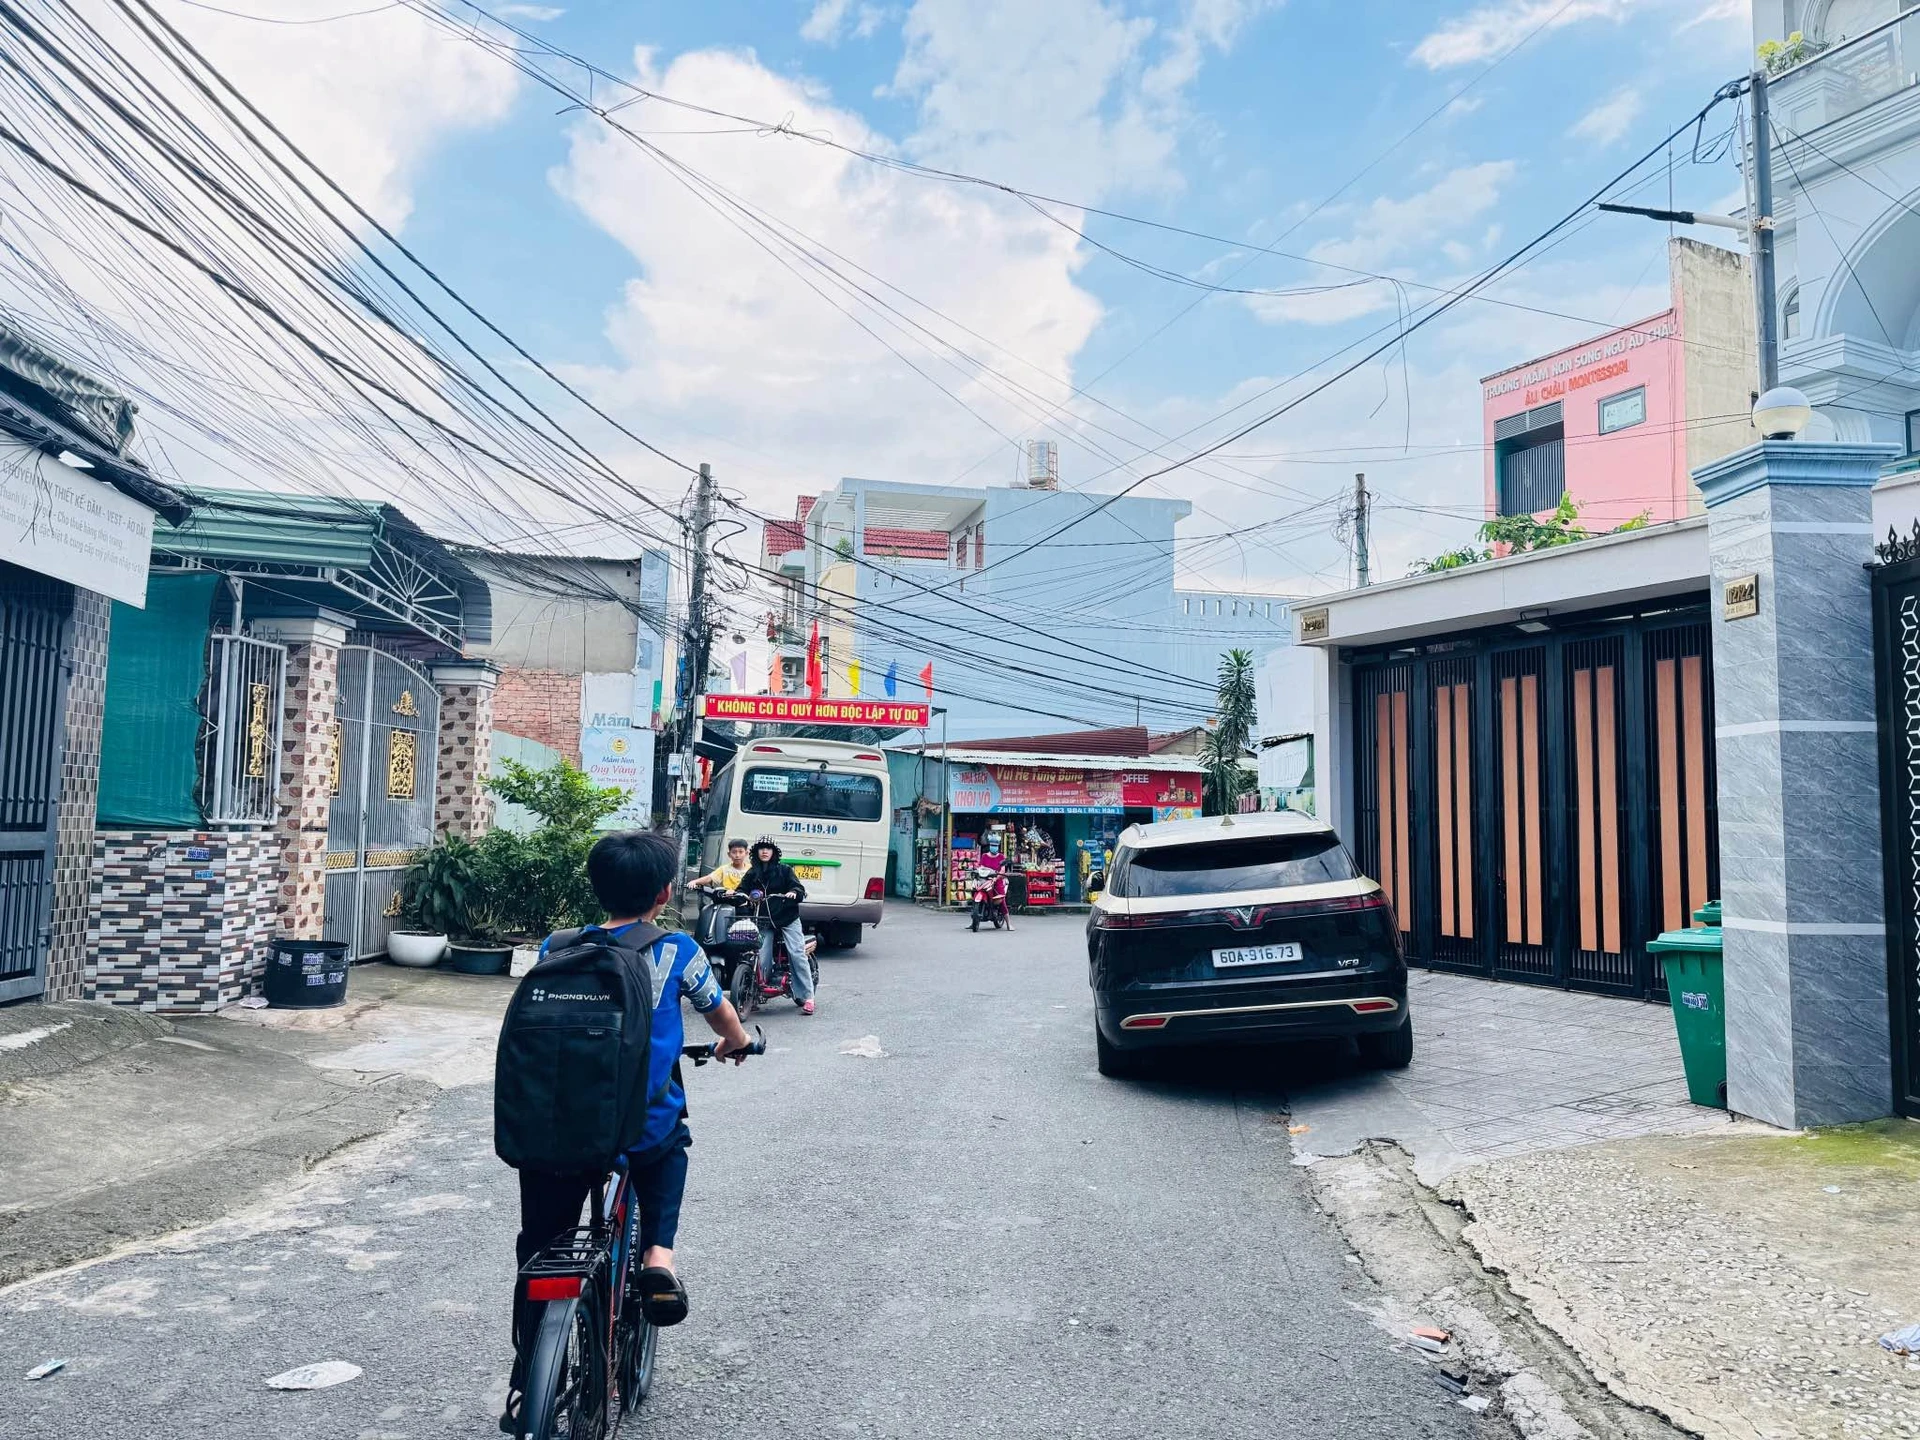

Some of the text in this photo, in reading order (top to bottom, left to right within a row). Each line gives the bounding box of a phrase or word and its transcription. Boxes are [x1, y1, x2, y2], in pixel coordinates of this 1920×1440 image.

[1553, 359, 1573, 377] NON
[1575, 348, 1602, 369] SONG
[759, 699, 774, 715] CÓ
[777, 699, 788, 716] GÌ
[791, 701, 813, 718] QUÝ
[815, 704, 838, 718] HƠN
[841, 704, 863, 721] ĐỘC
[865, 704, 886, 722] LẬP
[889, 707, 903, 723] TỰ
[1121, 774, 1149, 784] OFFEE
[1220, 946, 1294, 964] 60A-916.73
[548, 993, 610, 1001] PHONGVU.VN
